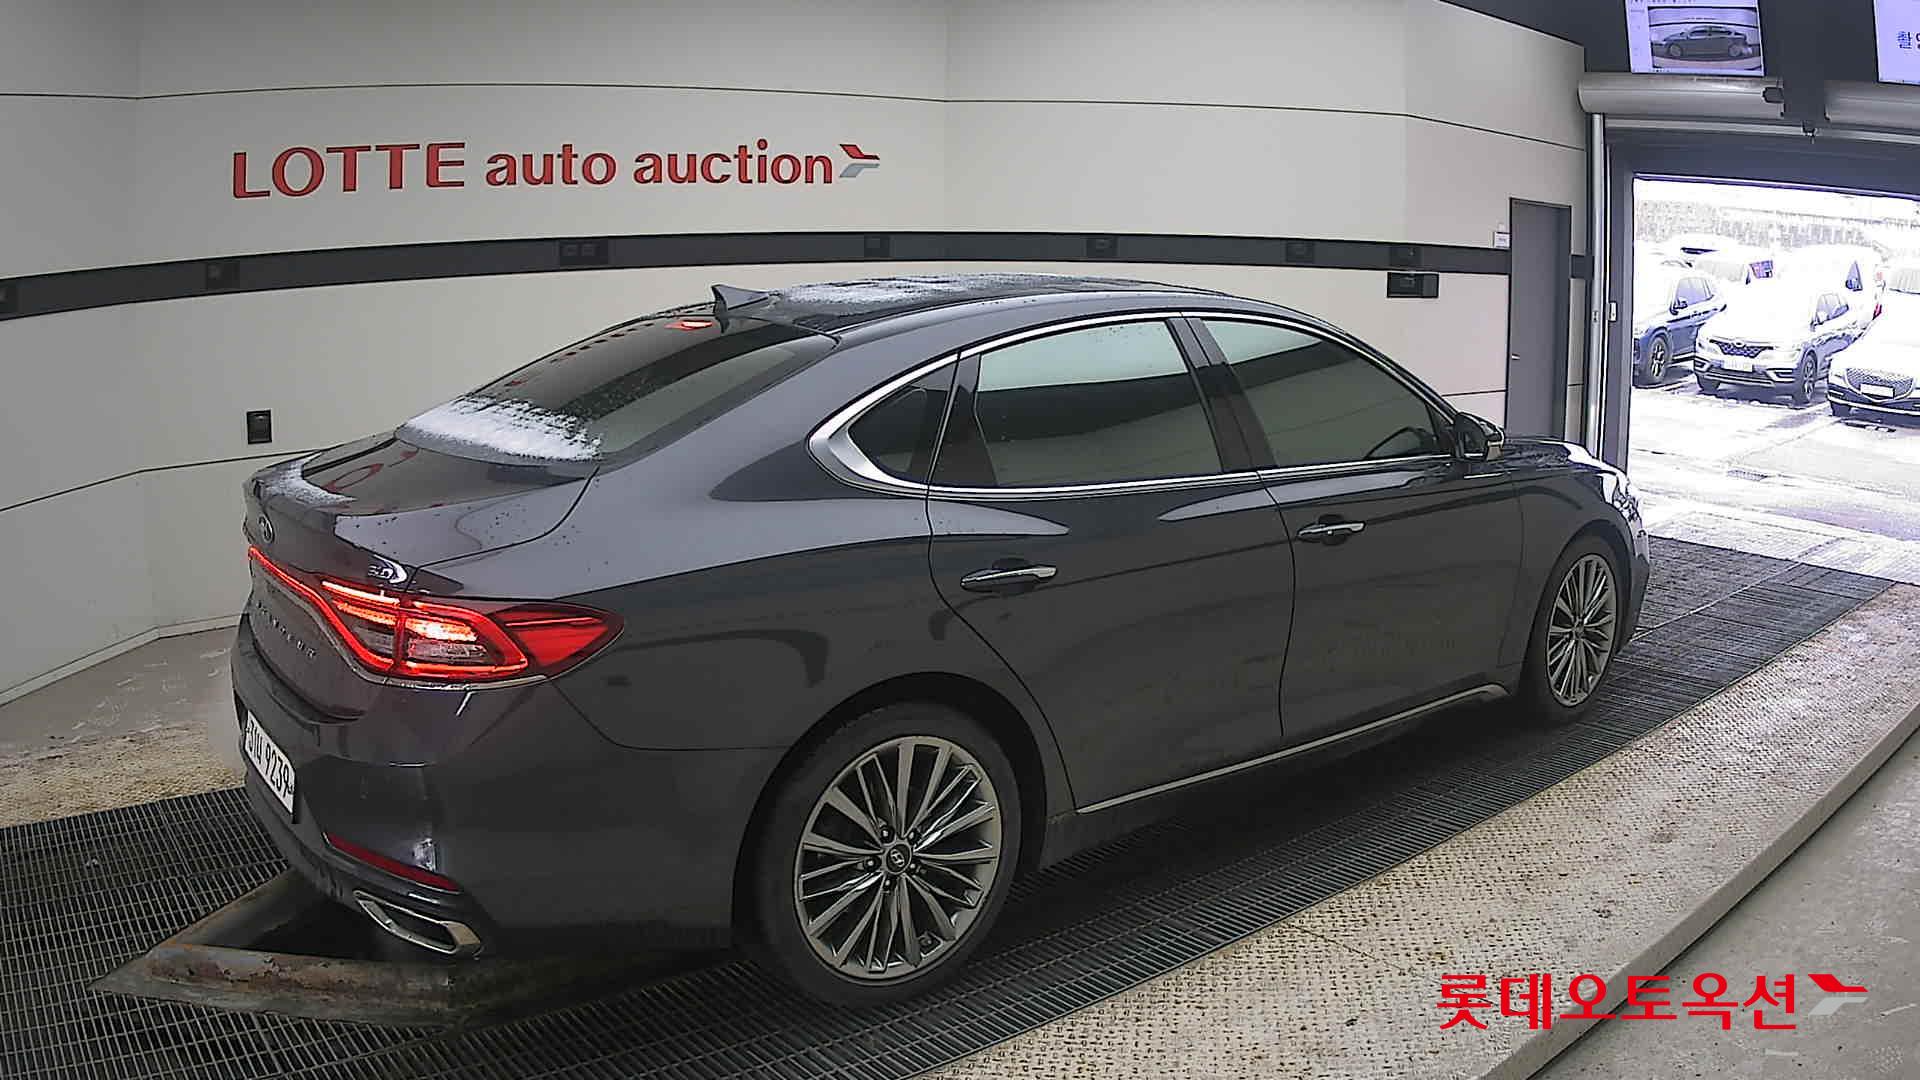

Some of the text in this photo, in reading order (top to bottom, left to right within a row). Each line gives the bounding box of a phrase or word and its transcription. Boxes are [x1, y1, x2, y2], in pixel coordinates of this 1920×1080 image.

[232, 138, 833, 199] LOTTE auto auction
[265, 743, 290, 798] 9239
